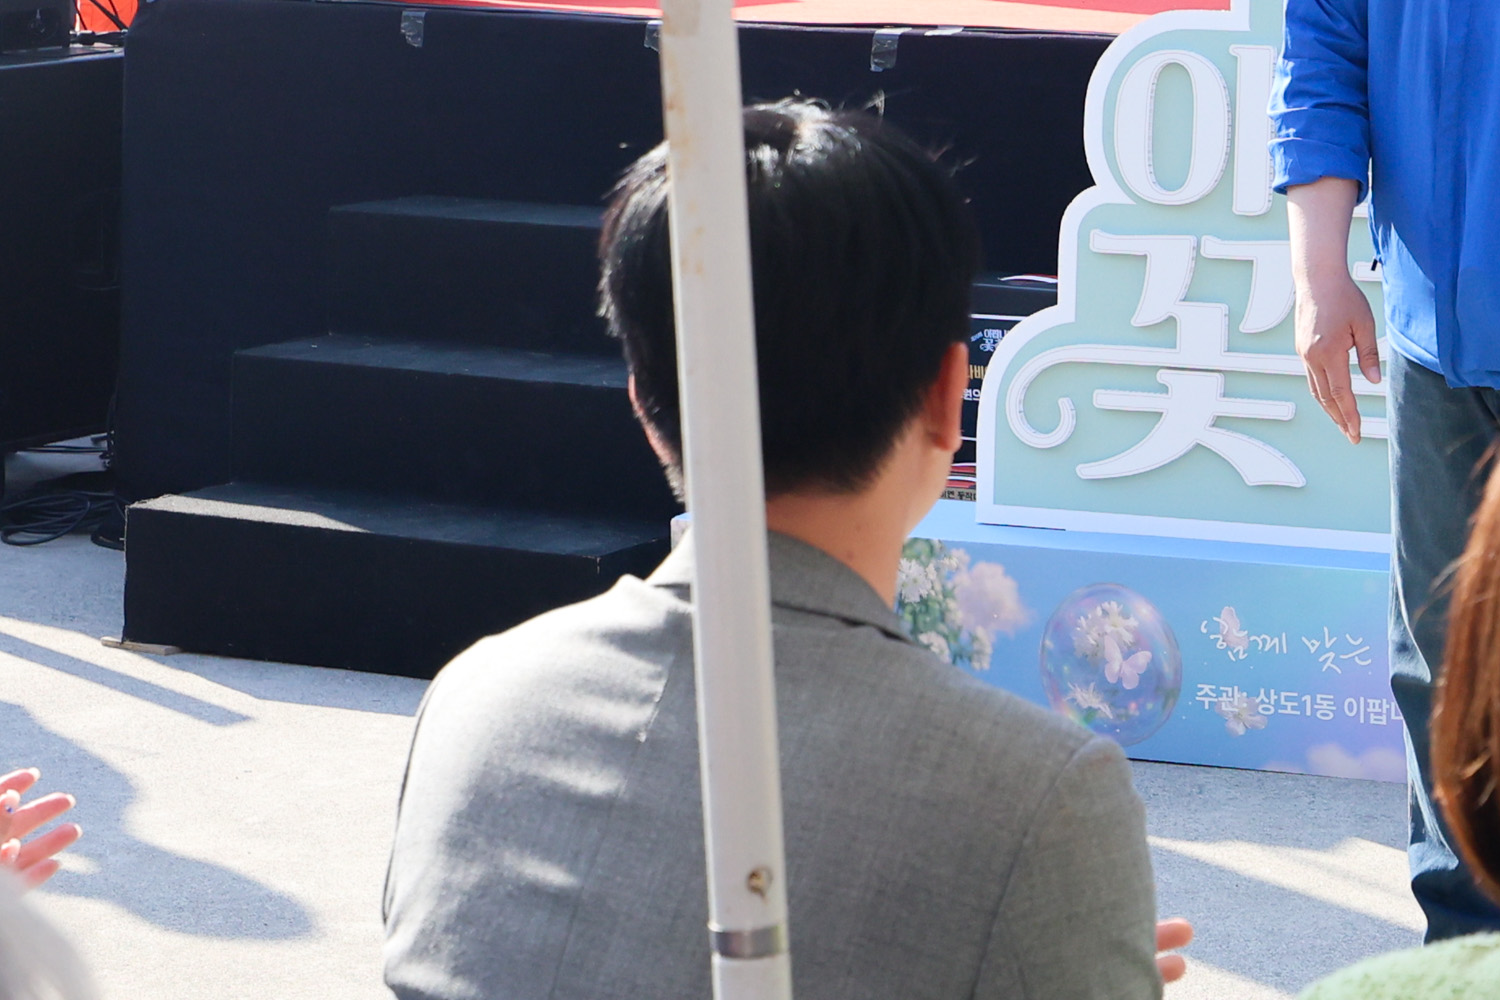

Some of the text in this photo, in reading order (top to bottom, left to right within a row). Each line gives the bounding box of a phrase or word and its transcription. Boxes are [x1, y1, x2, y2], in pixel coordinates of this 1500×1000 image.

[1301, 625, 1372, 675] 맞는
[1195, 683, 1248, 713] 주관:
[1255, 687, 1337, 721] 상도1동
